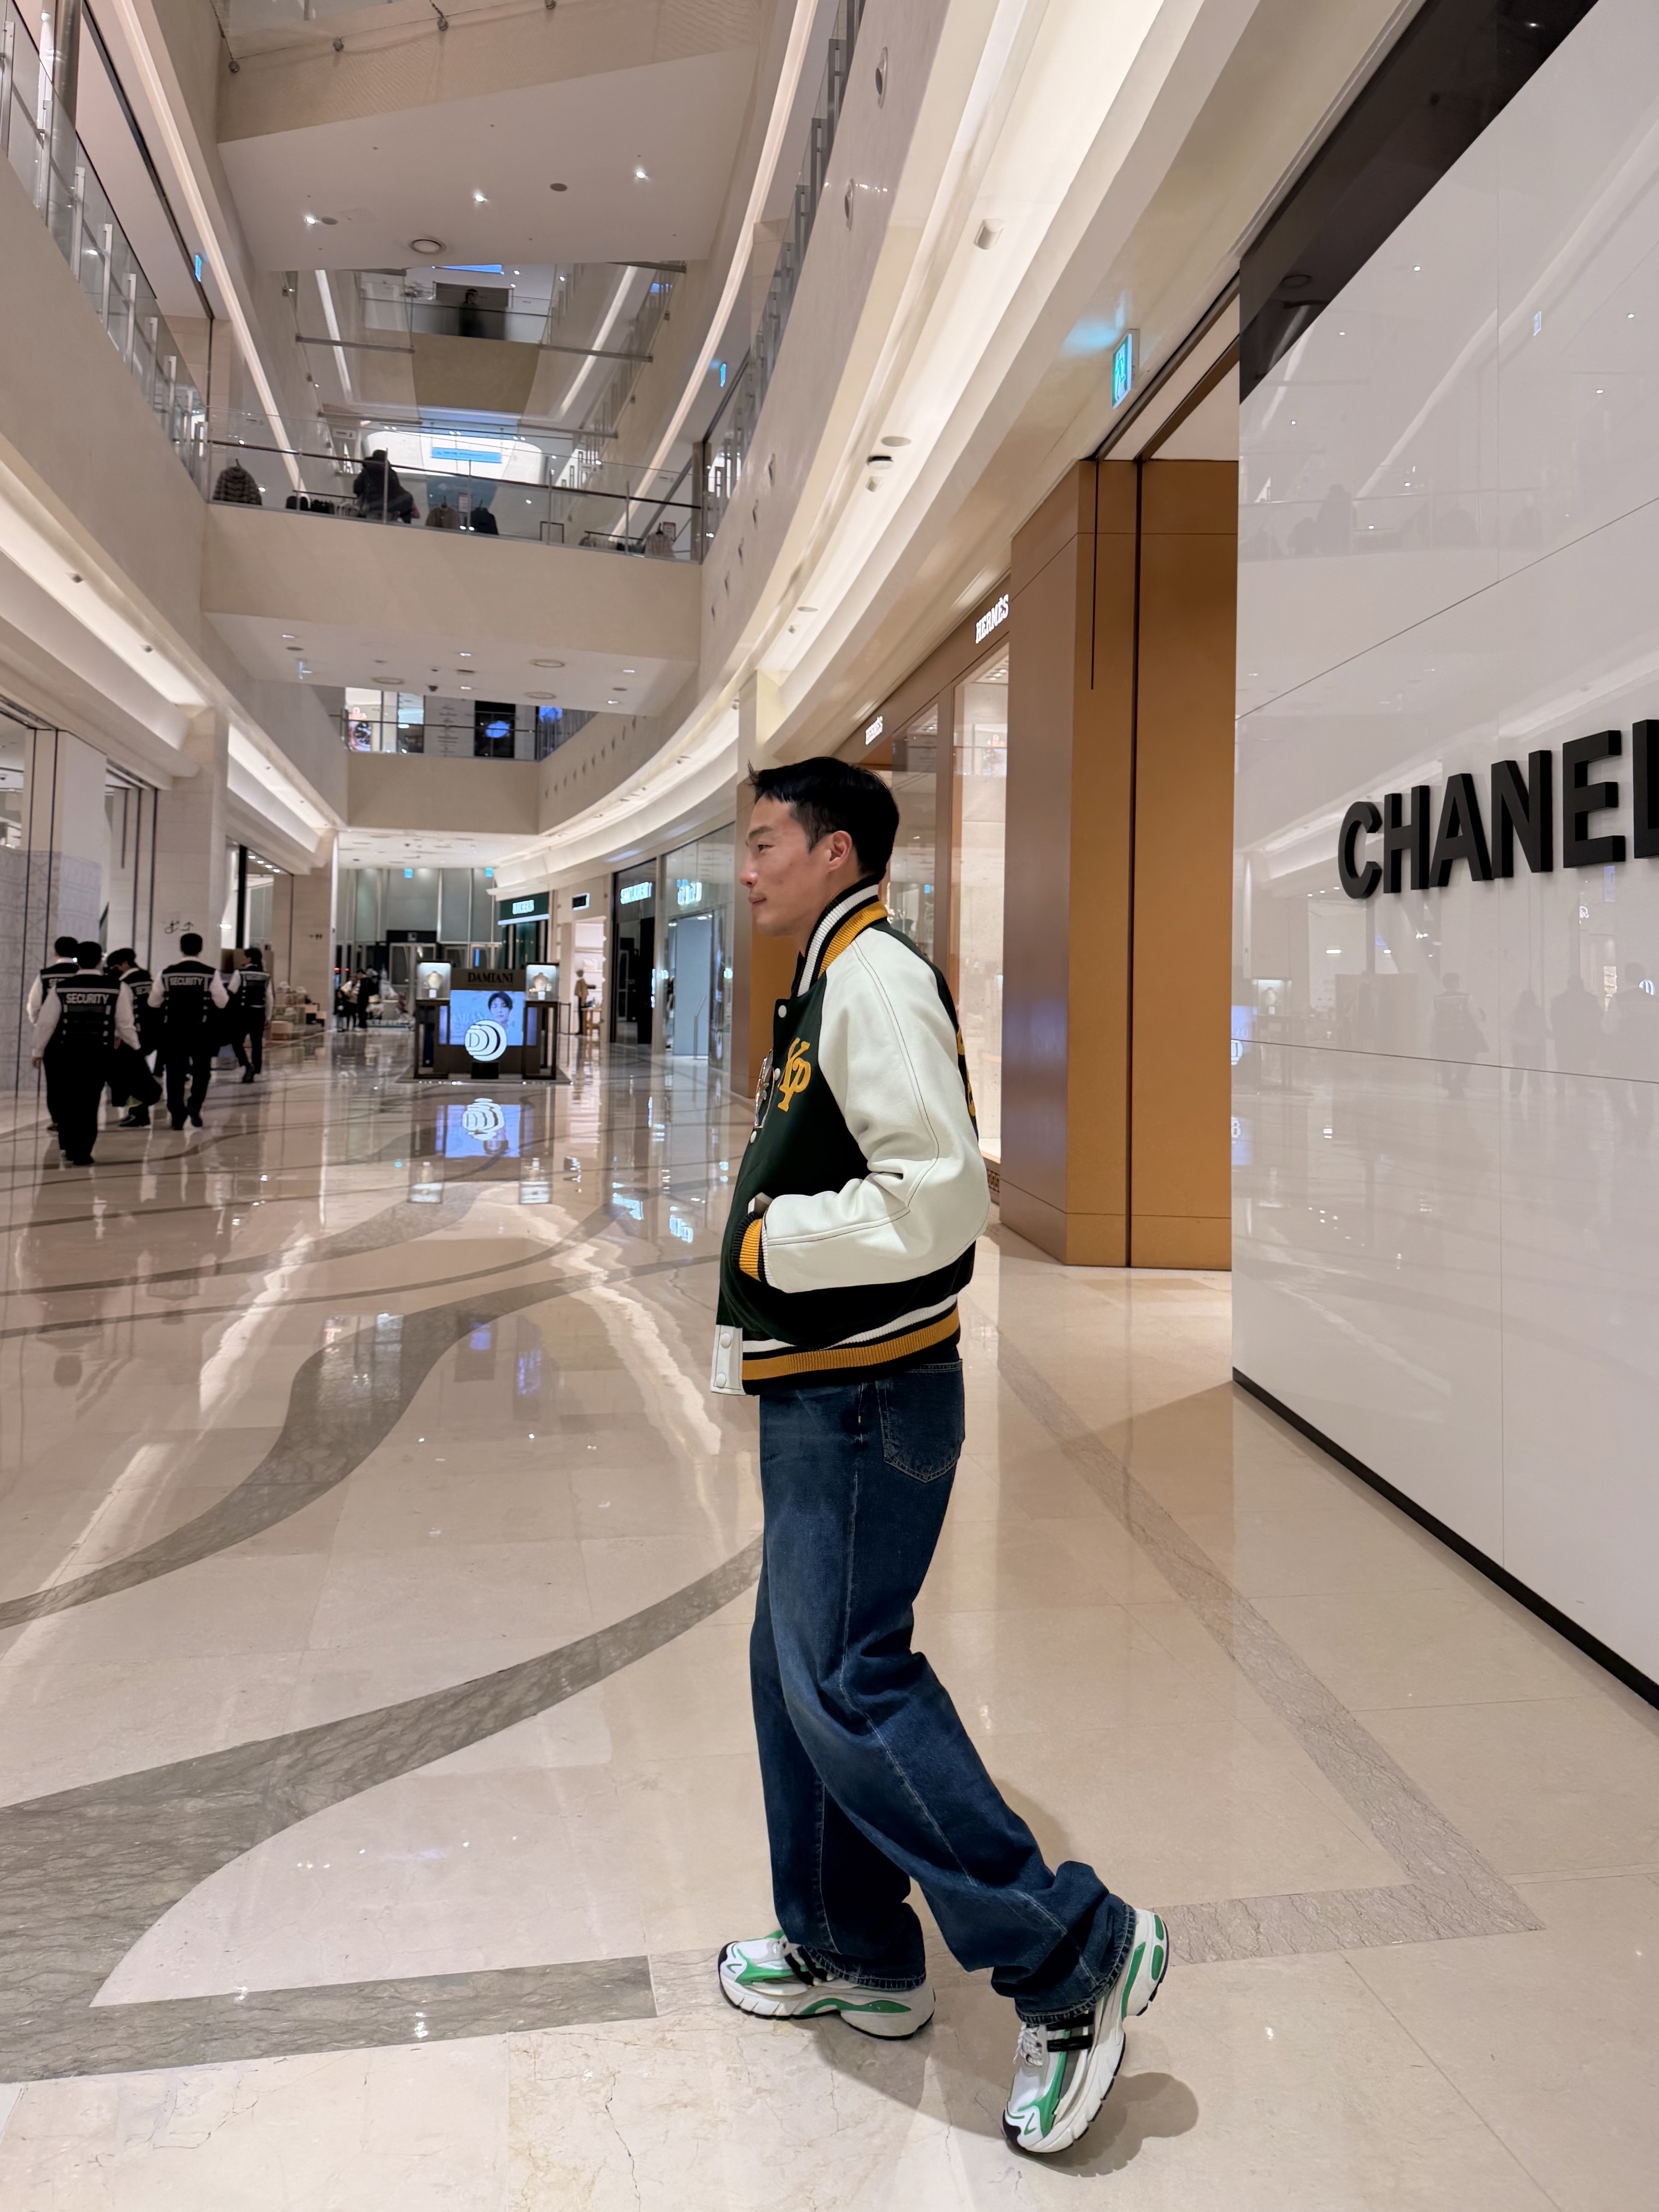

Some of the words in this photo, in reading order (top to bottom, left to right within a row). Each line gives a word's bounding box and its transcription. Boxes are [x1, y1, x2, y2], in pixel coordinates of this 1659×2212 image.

[975, 594, 1009, 644] HERMÈS
[169, 977, 203, 986] SECURITY
[467, 972, 513, 983] DAMIANI
[66, 993, 110, 1004] SECURITY
